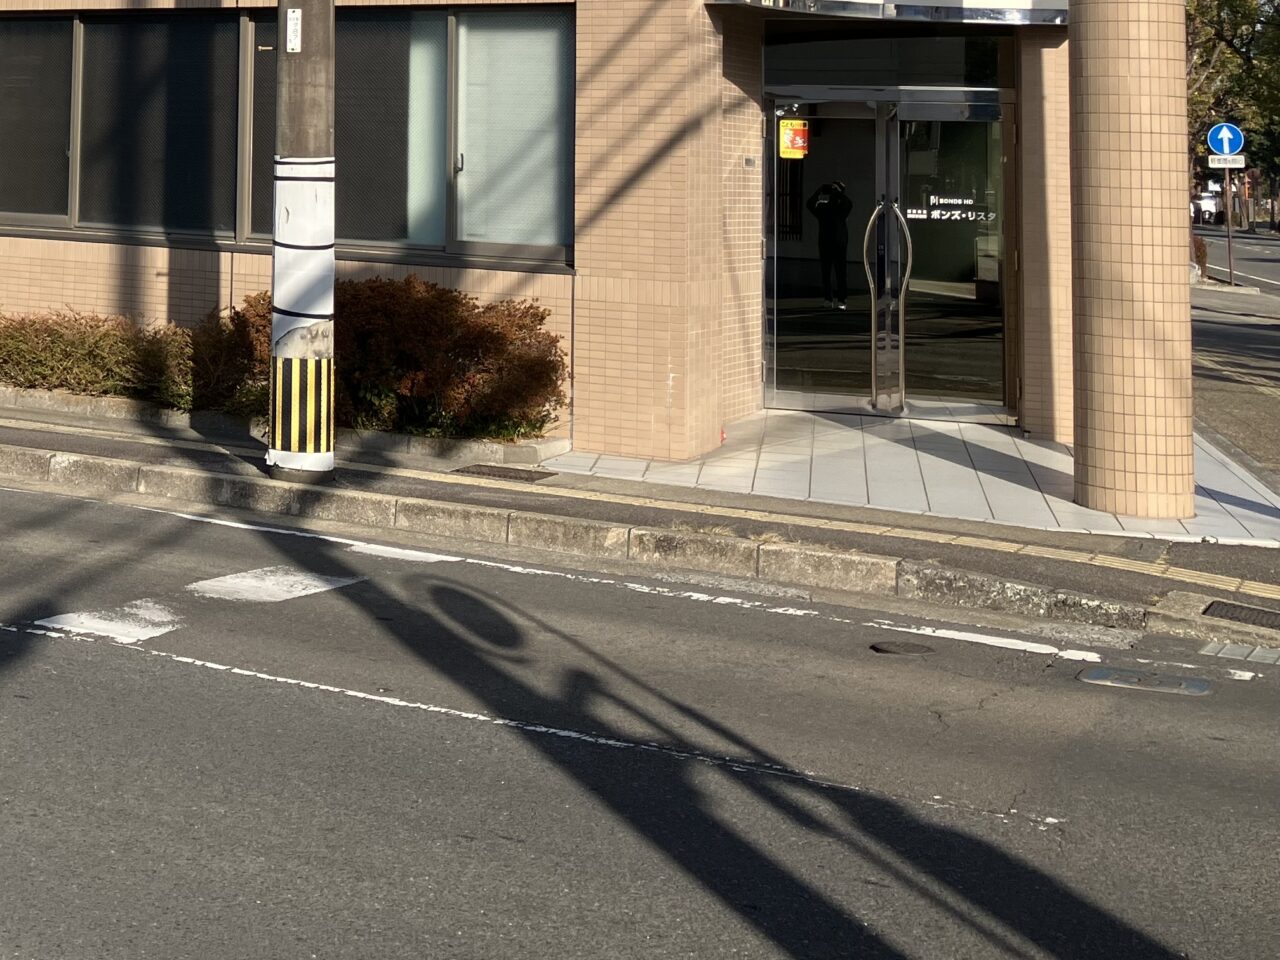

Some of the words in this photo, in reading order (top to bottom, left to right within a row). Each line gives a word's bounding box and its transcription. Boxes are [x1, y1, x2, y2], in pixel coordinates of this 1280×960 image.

[931, 209, 996, 221] ボンズ・リスタ
